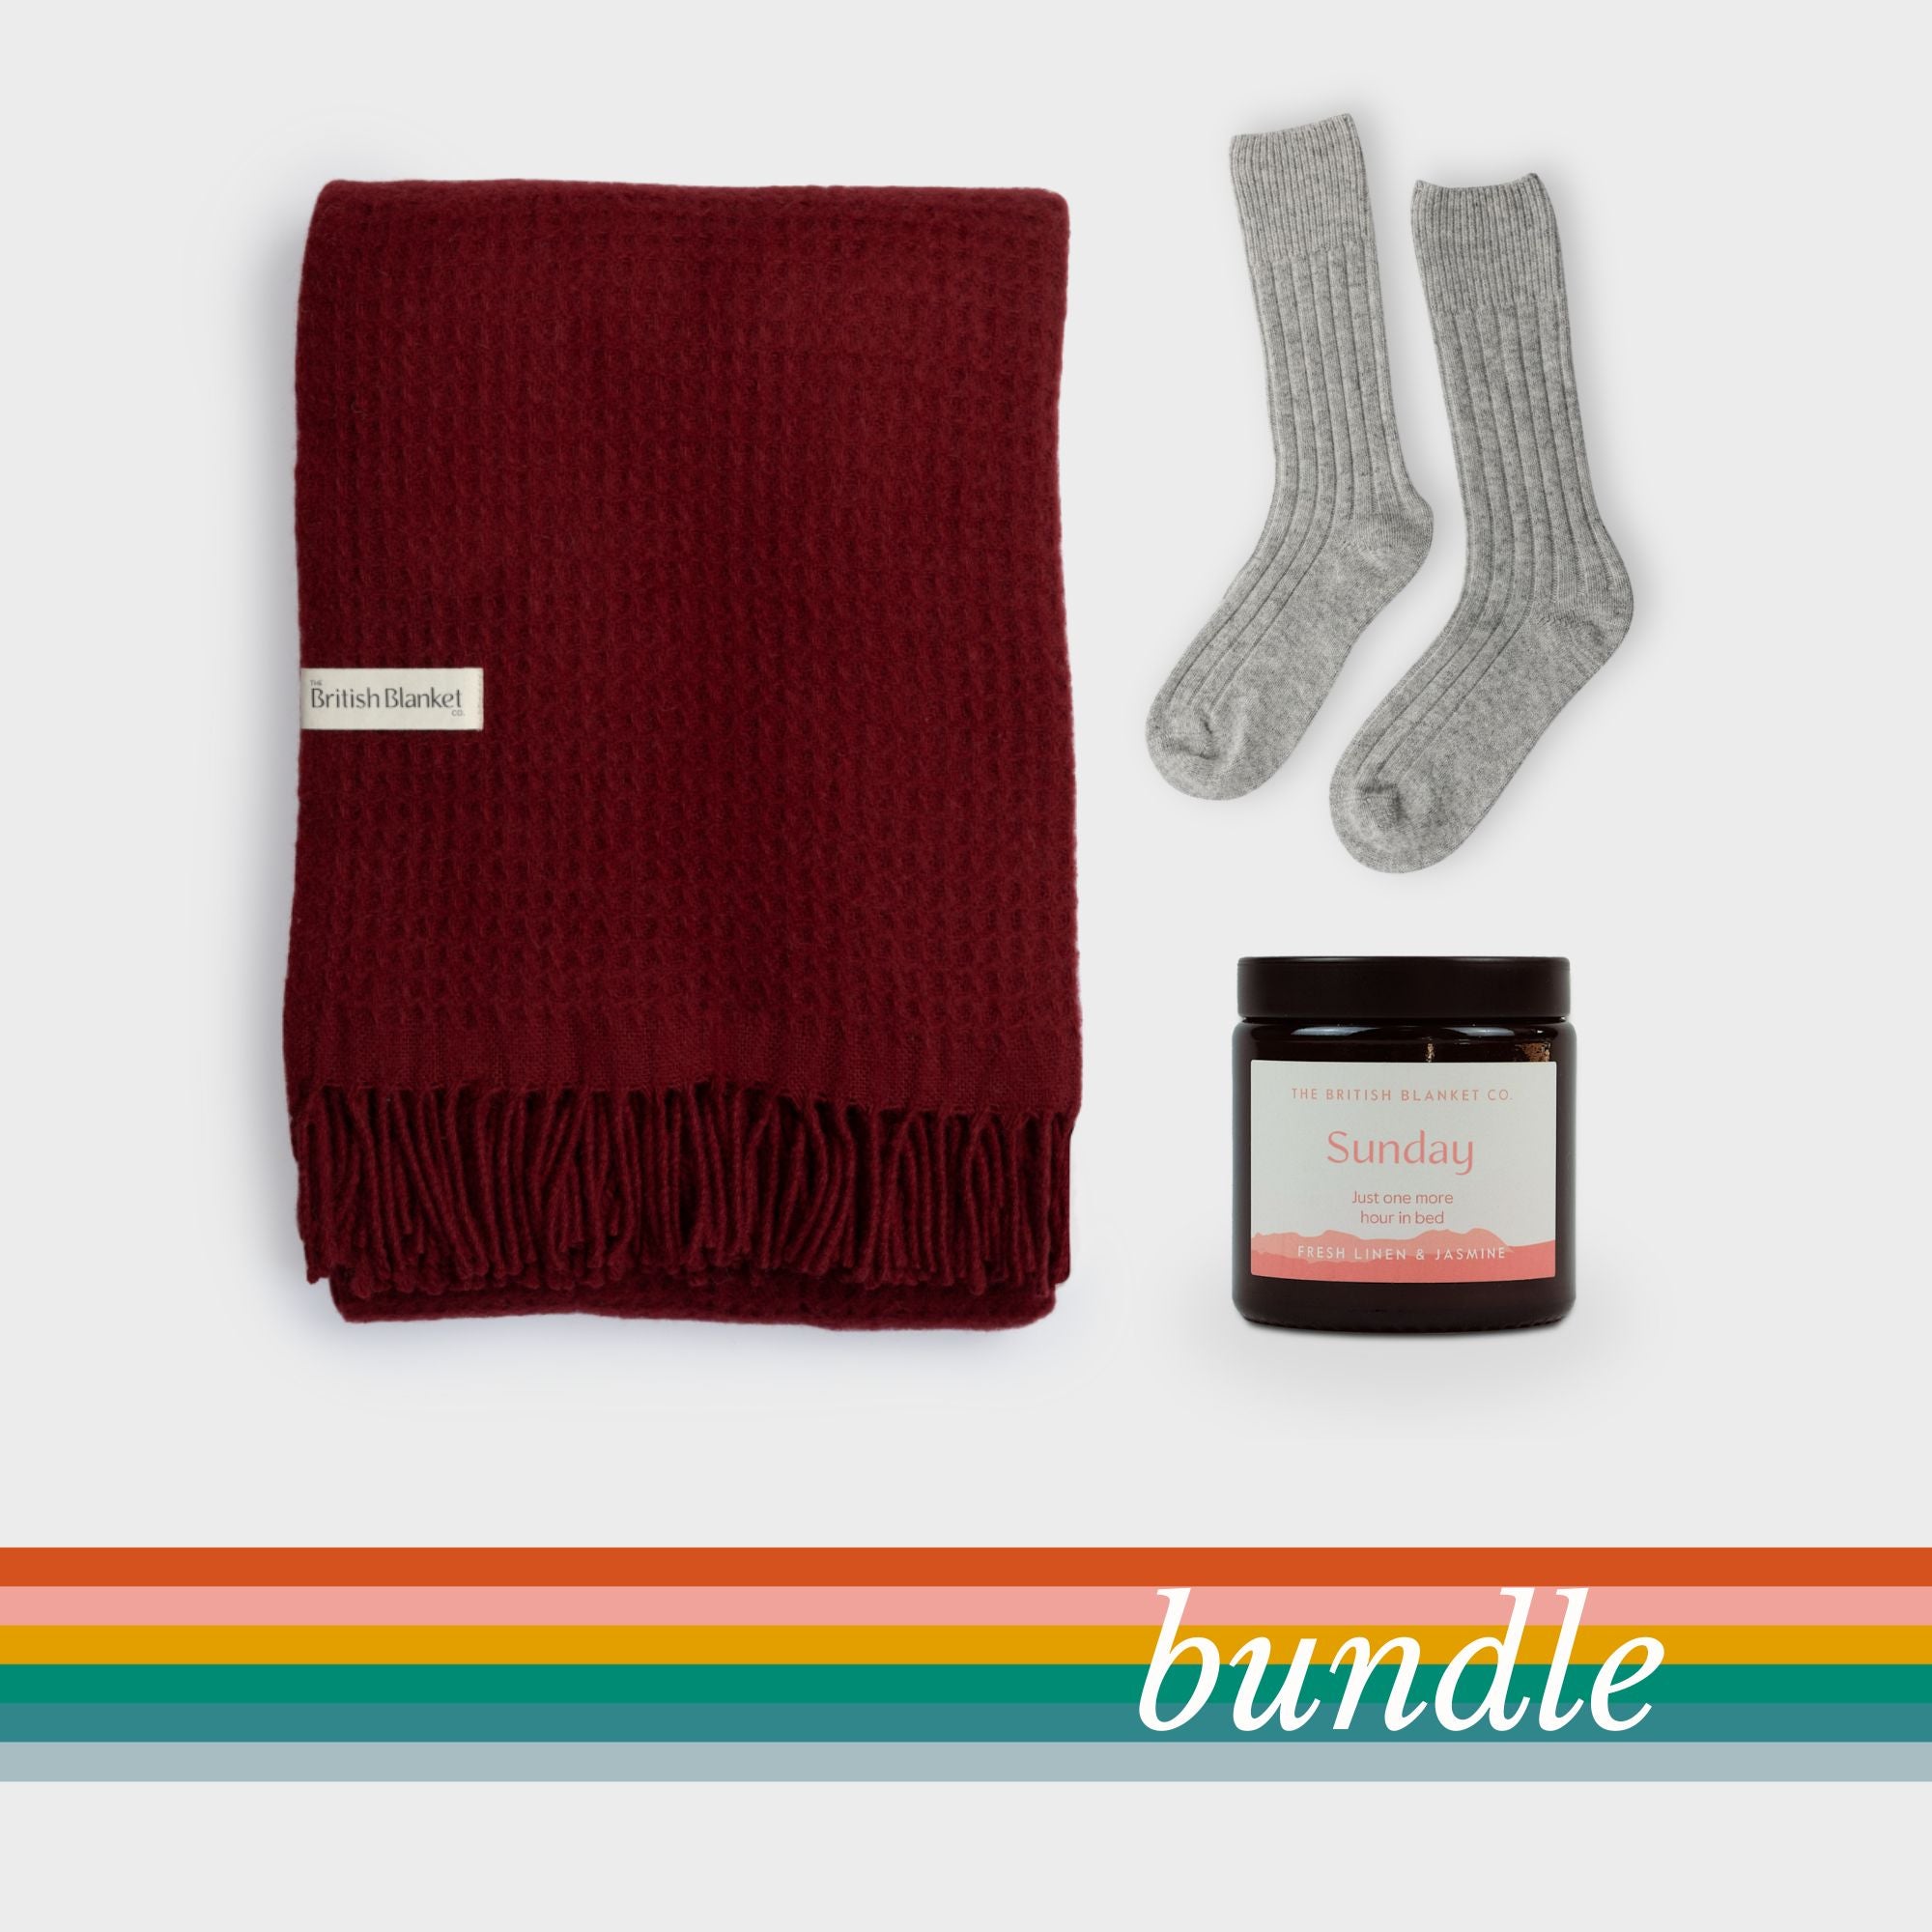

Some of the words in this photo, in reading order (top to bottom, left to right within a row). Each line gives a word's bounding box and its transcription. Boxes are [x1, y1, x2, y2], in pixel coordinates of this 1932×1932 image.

[311, 687, 380, 709] British
[384, 687, 463, 709] Blanket
[1292, 1088, 1319, 1100] THE
[1325, 1088, 1392, 1101] BRITISH
[1401, 1089, 1480, 1101] BLANKET
[1487, 1088, 1513, 1101] CO.
[1326, 1129, 1474, 1177] Sunday
[1351, 1190, 1380, 1205] Just
[1382, 1193, 1412, 1205] one
[1415, 1193, 1454, 1205] more
[1360, 1210, 1395, 1224] hour
[1398, 1210, 1411, 1224] in
[1414, 1209, 1444, 1224] bed
[1297, 1244, 1346, 1260] FRESH
[1354, 1246, 1406, 1261] LINEN
[1415, 1247, 1426, 1261] &
[1435, 1245, 1506, 1261] JASMINE
